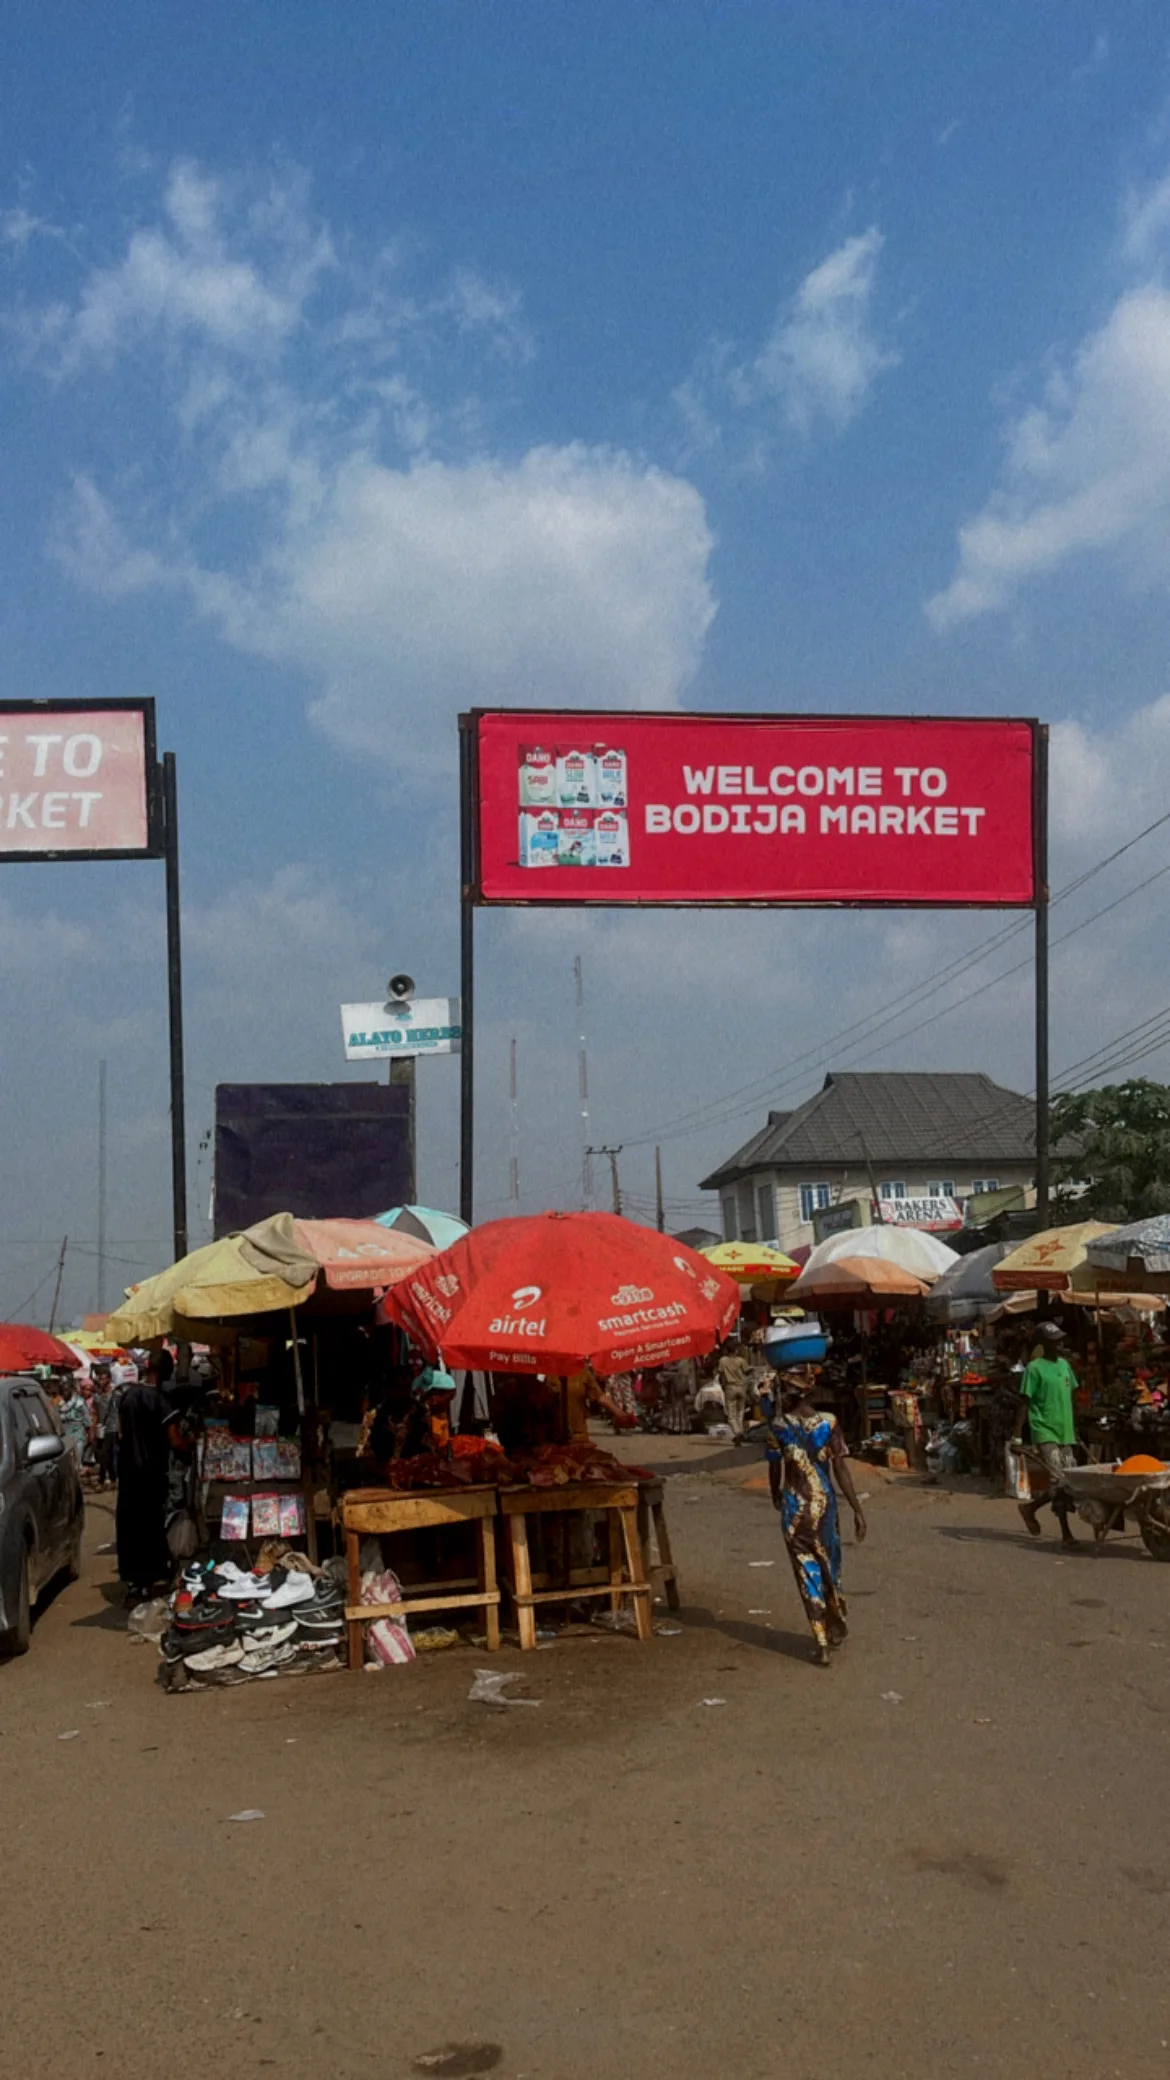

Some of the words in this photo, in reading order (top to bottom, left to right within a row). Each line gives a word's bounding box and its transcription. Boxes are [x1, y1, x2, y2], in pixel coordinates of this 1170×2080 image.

[26, 733, 103, 777] TO
[683, 765, 882, 796] WELCOME
[894, 767, 948, 797] TO
[0, 791, 103, 829] KET
[645, 804, 806, 834] BODIJA
[820, 805, 986, 836] MARKET
[348, 1030, 402, 1047] ALAYO
[895, 1200, 947, 1212] BAKERS
[896, 1210, 944, 1221] ARENA
[489, 1314, 547, 1337] airtel
[598, 1301, 687, 1332] smartcash
[490, 1351, 510, 1365] Pay
